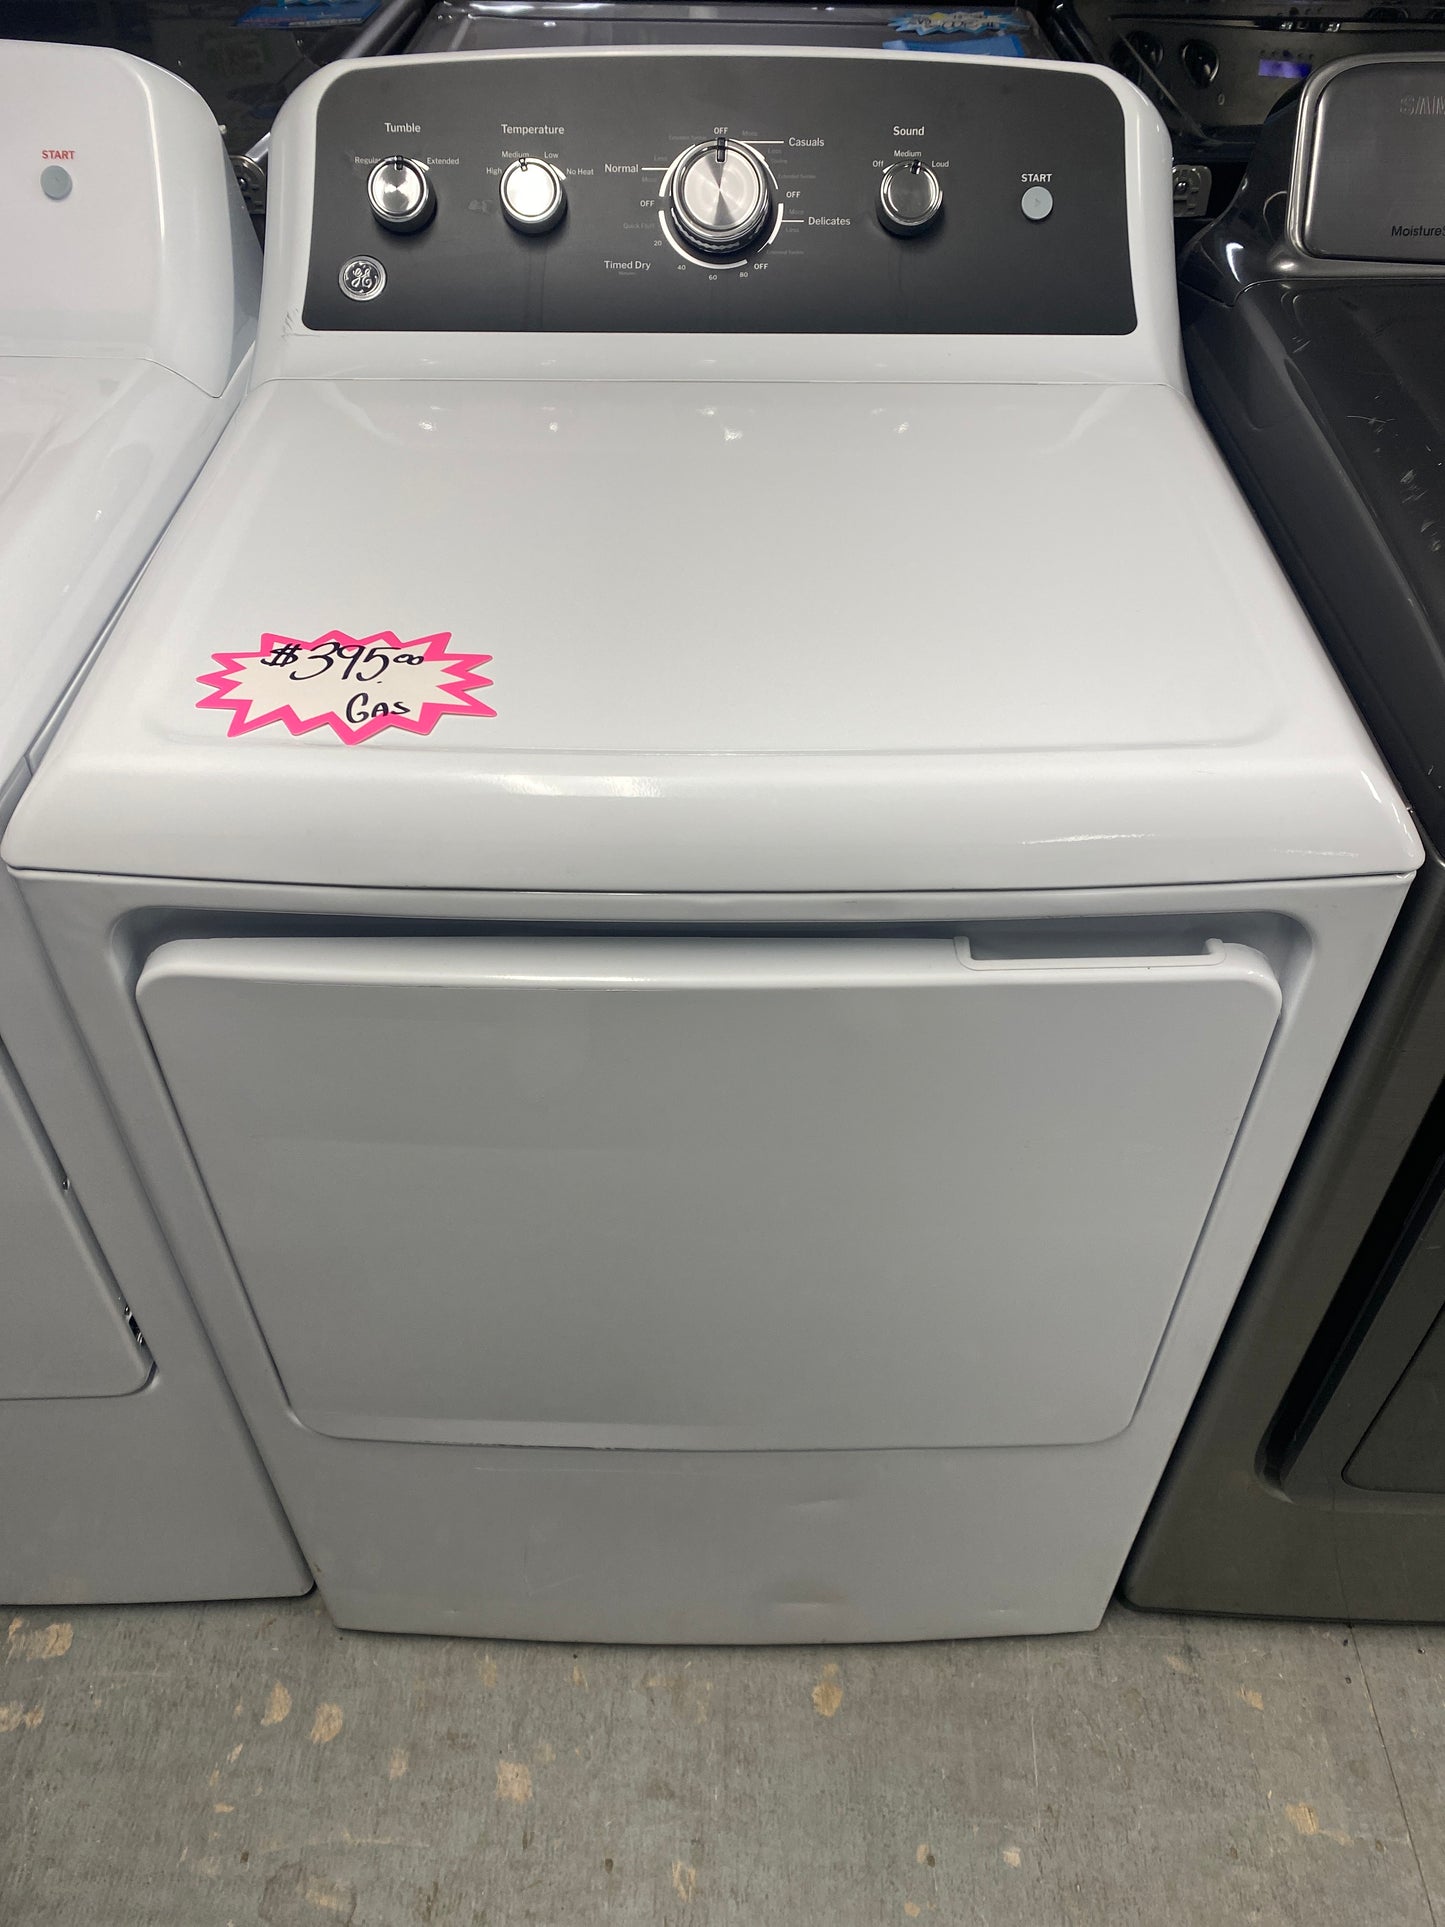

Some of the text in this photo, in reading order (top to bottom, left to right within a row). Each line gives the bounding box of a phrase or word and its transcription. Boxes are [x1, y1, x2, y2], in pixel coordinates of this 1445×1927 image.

[384, 122, 421, 133] Tumble
[501, 123, 565, 136] Temperature
[713, 127, 729, 135] OFF
[893, 126, 925, 136] Sound
[788, 137, 825, 147] Casuals
[41, 150, 76, 160] START
[544, 151, 559, 159] Low
[426, 157, 460, 165] Extended
[931, 160, 950, 168] Loud
[486, 167, 502, 176] High
[566, 168, 594, 176] No Heat
[604, 163, 639, 173] Normal
[1021, 173, 1053, 182] START
[808, 216, 851, 226] Delicates
[604, 260, 651, 271] Timed Dry
